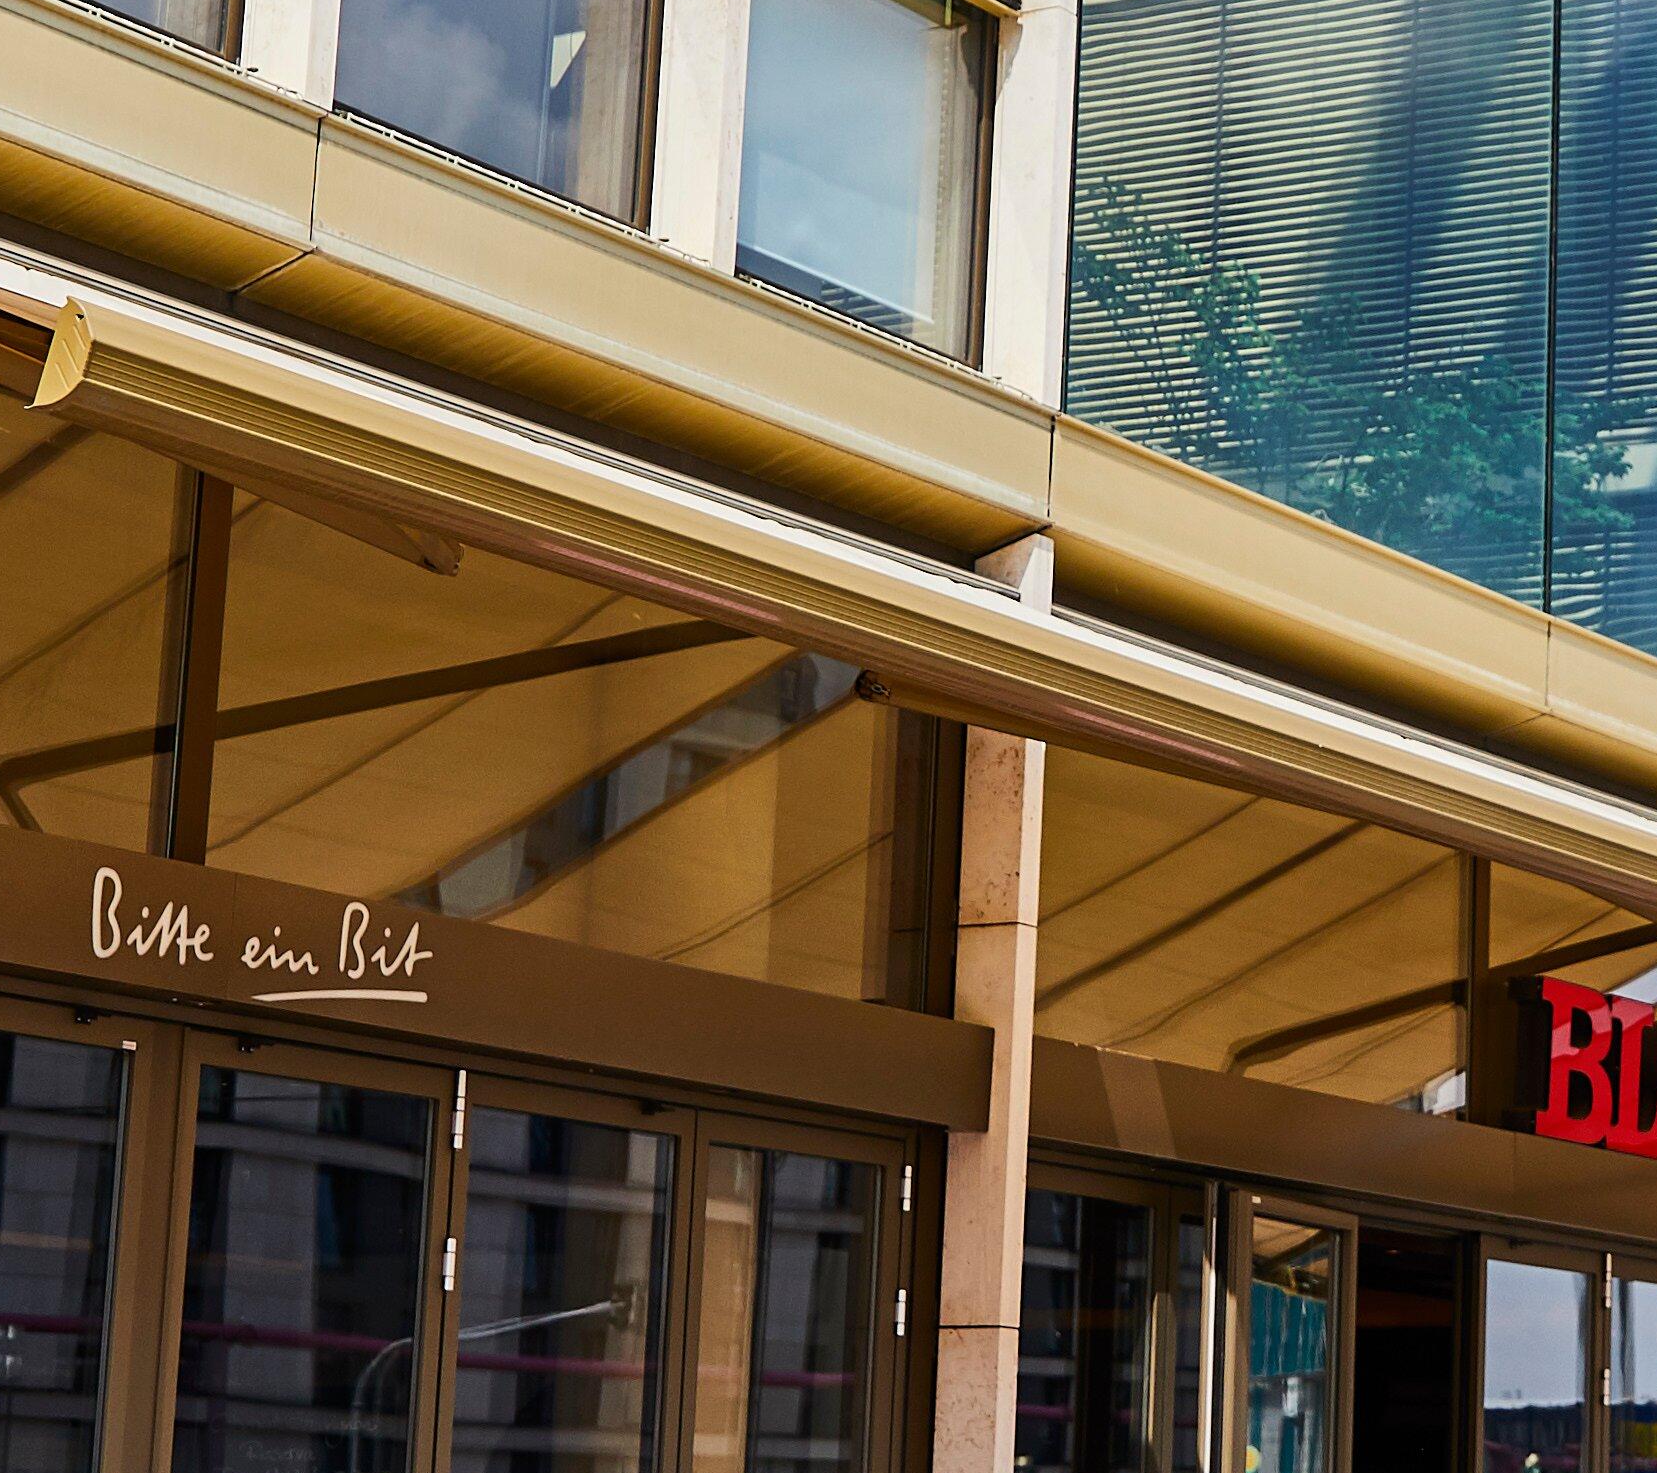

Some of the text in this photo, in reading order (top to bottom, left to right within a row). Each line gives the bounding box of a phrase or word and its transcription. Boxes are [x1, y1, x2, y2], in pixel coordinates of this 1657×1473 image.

[91, 866, 433, 980] Bitte ein Bit
